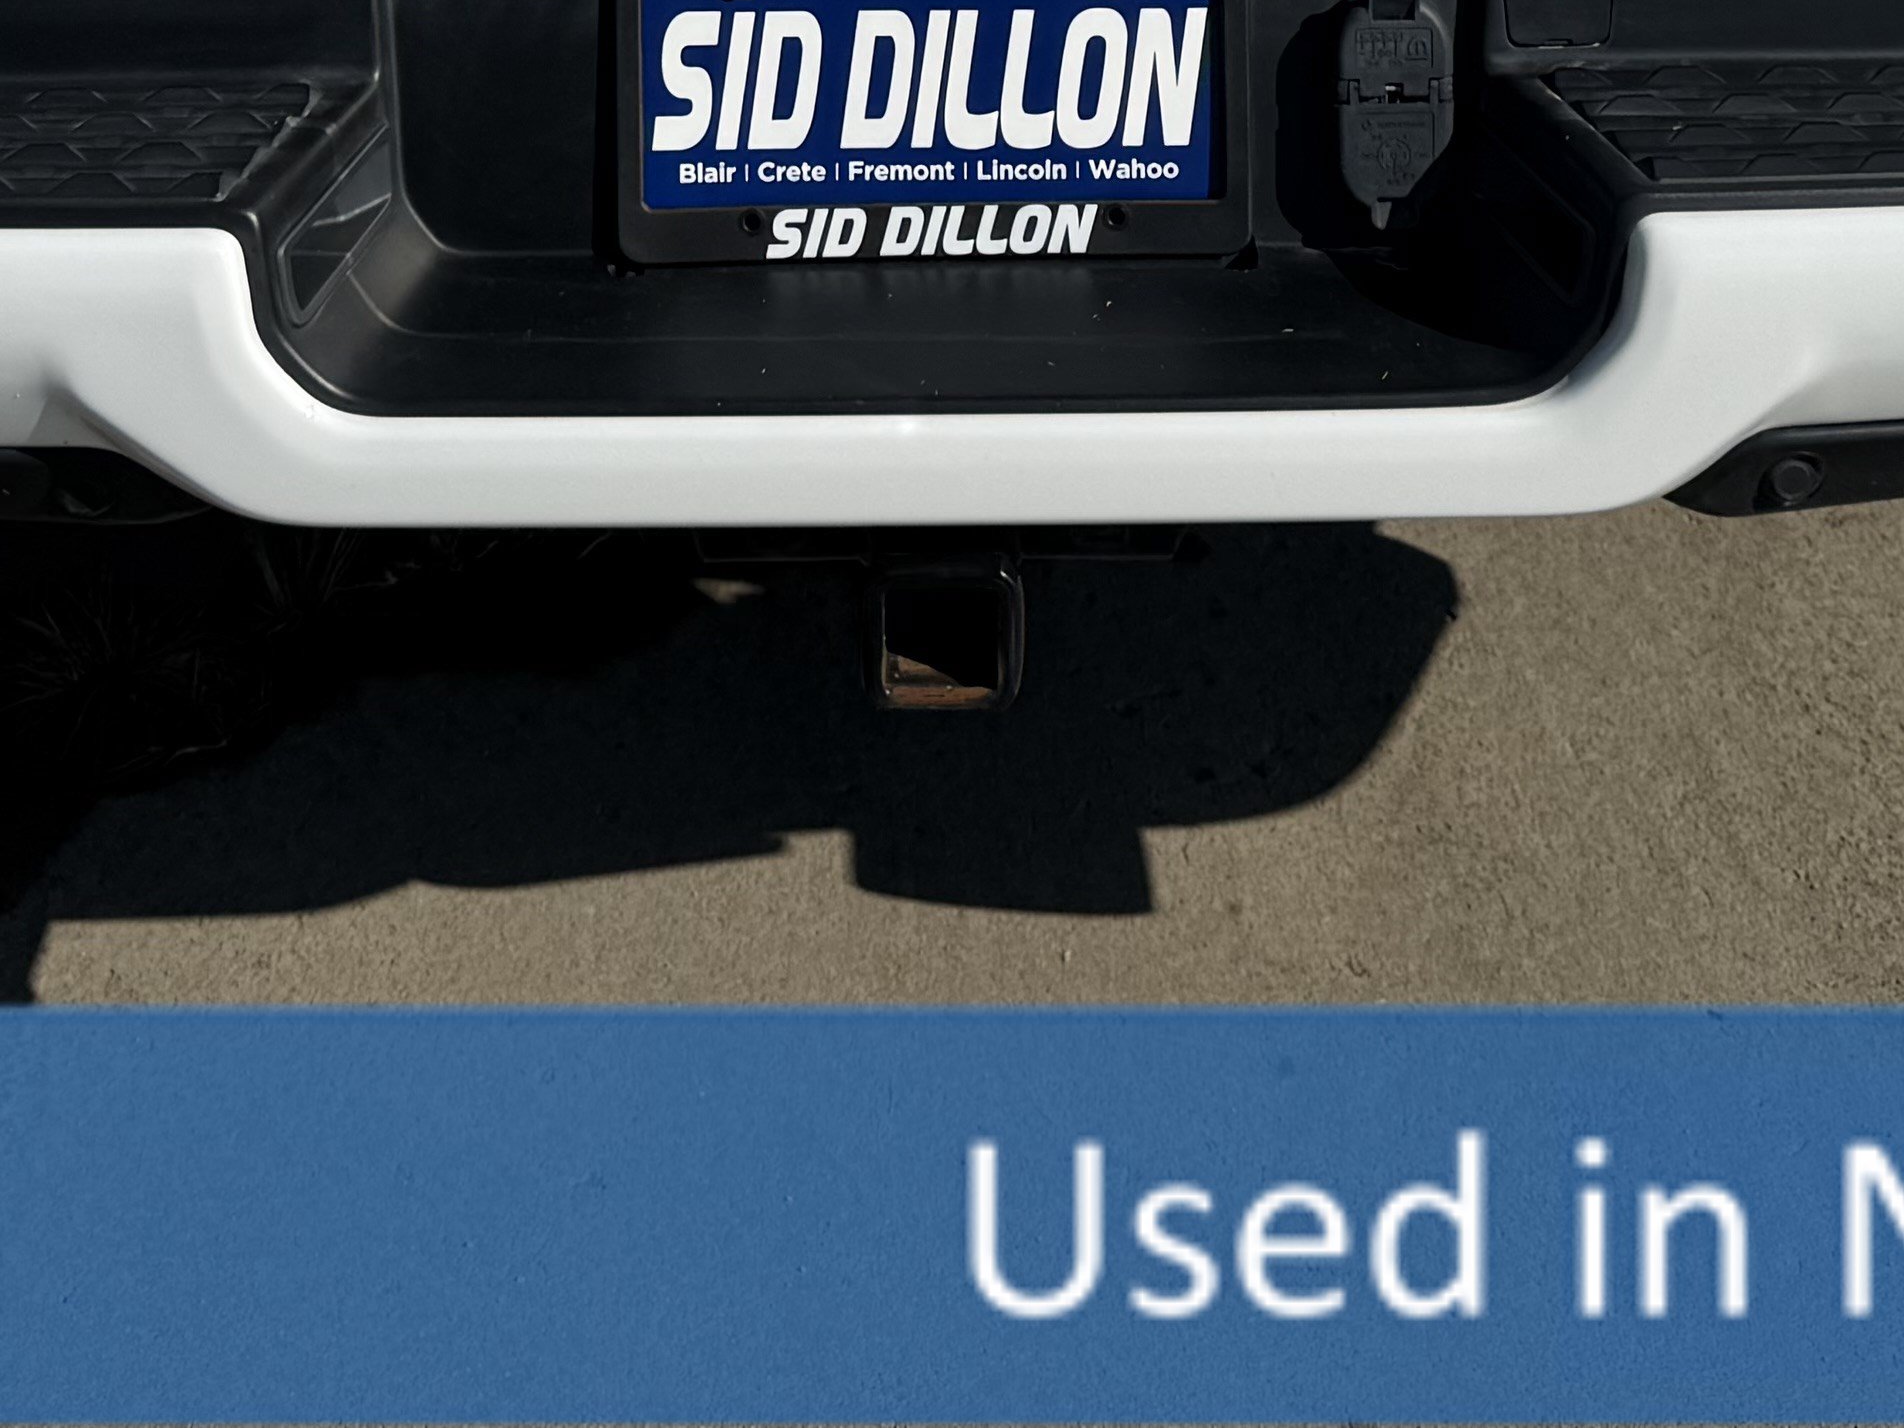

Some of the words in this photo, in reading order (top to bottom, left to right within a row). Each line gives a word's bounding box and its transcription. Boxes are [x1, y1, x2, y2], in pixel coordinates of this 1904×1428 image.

[651, 10, 822, 152] SID
[839, 7, 1209, 150] DILLON
[679, 162, 737, 183] Blair
[757, 162, 827, 182] Crete
[848, 161, 955, 181] Fremont
[976, 159, 1067, 180] Lincoln
[1088, 158, 1180, 179] Wahoo
[765, 207, 868, 260] SID
[879, 203, 1099, 257] DILLON
